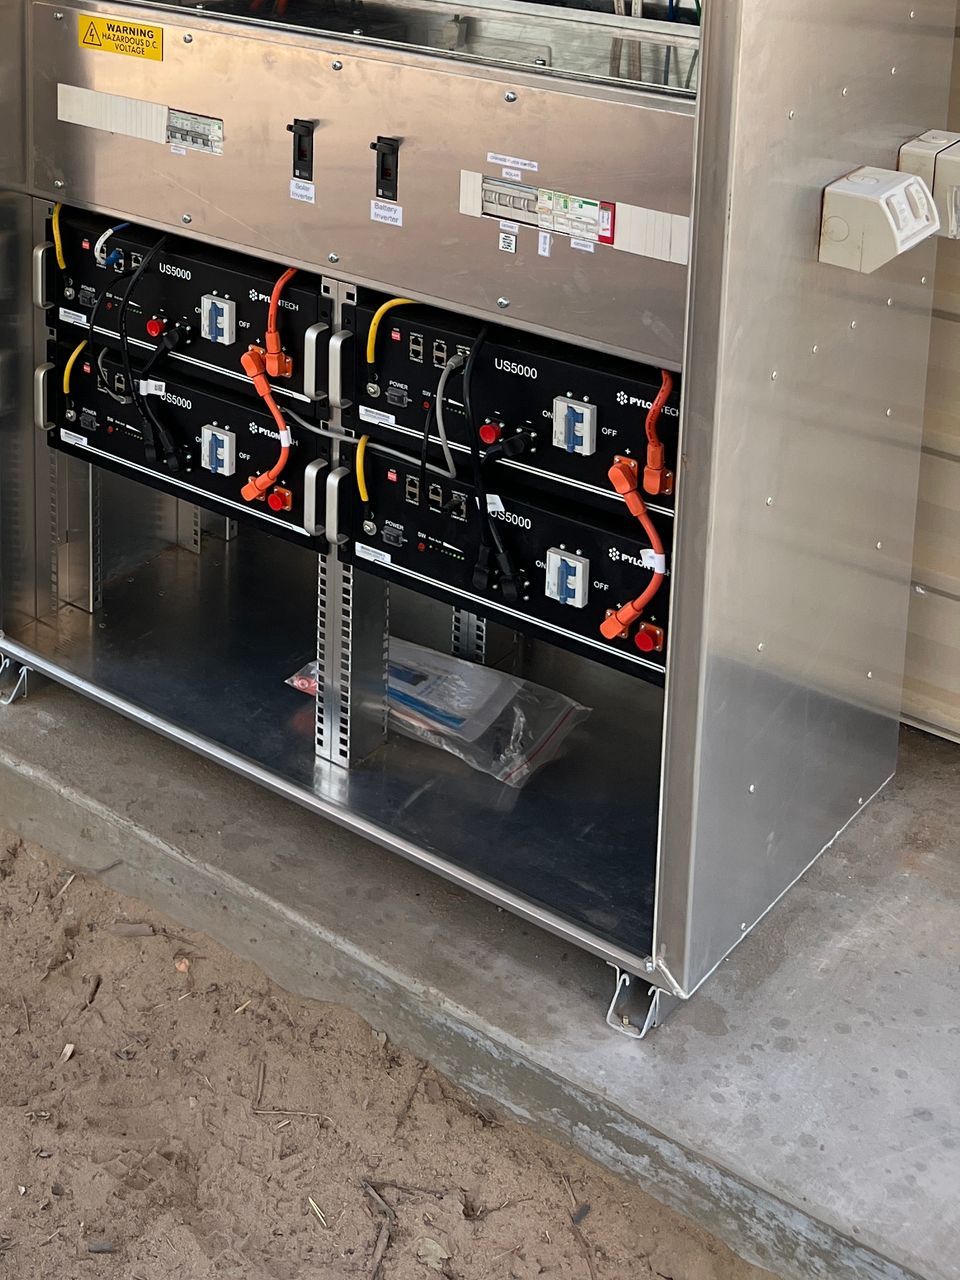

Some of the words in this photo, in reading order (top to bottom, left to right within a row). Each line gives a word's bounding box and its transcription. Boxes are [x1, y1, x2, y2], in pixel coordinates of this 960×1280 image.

[106, 23, 154, 38] WARNING
[102, 32, 144, 46] HAZARDOUS
[115, 43, 145, 55] VOLTAGE
[295, 183, 310, 192] Solar
[292, 192, 313, 201] Inverter
[374, 202, 398, 214] Battery
[374, 212, 399, 223] Inverter
[160, 262, 191, 281] US5000
[81, 284, 96, 292] POWER
[259, 294, 299, 311] PYLTECH
[239, 320, 250, 328] OFF
[494, 358, 538, 380] US5000
[389, 380, 408, 390] POWER
[161, 392, 192, 410] US5000
[82, 407, 97, 416] POWER
[542, 410, 553, 419] ON
[602, 428, 617, 437] OFF
[239, 452, 250, 460] OFF
[385, 520, 404, 530] POWER
[490, 510, 531, 529] US5000
[594, 580, 609, 591] OFF
